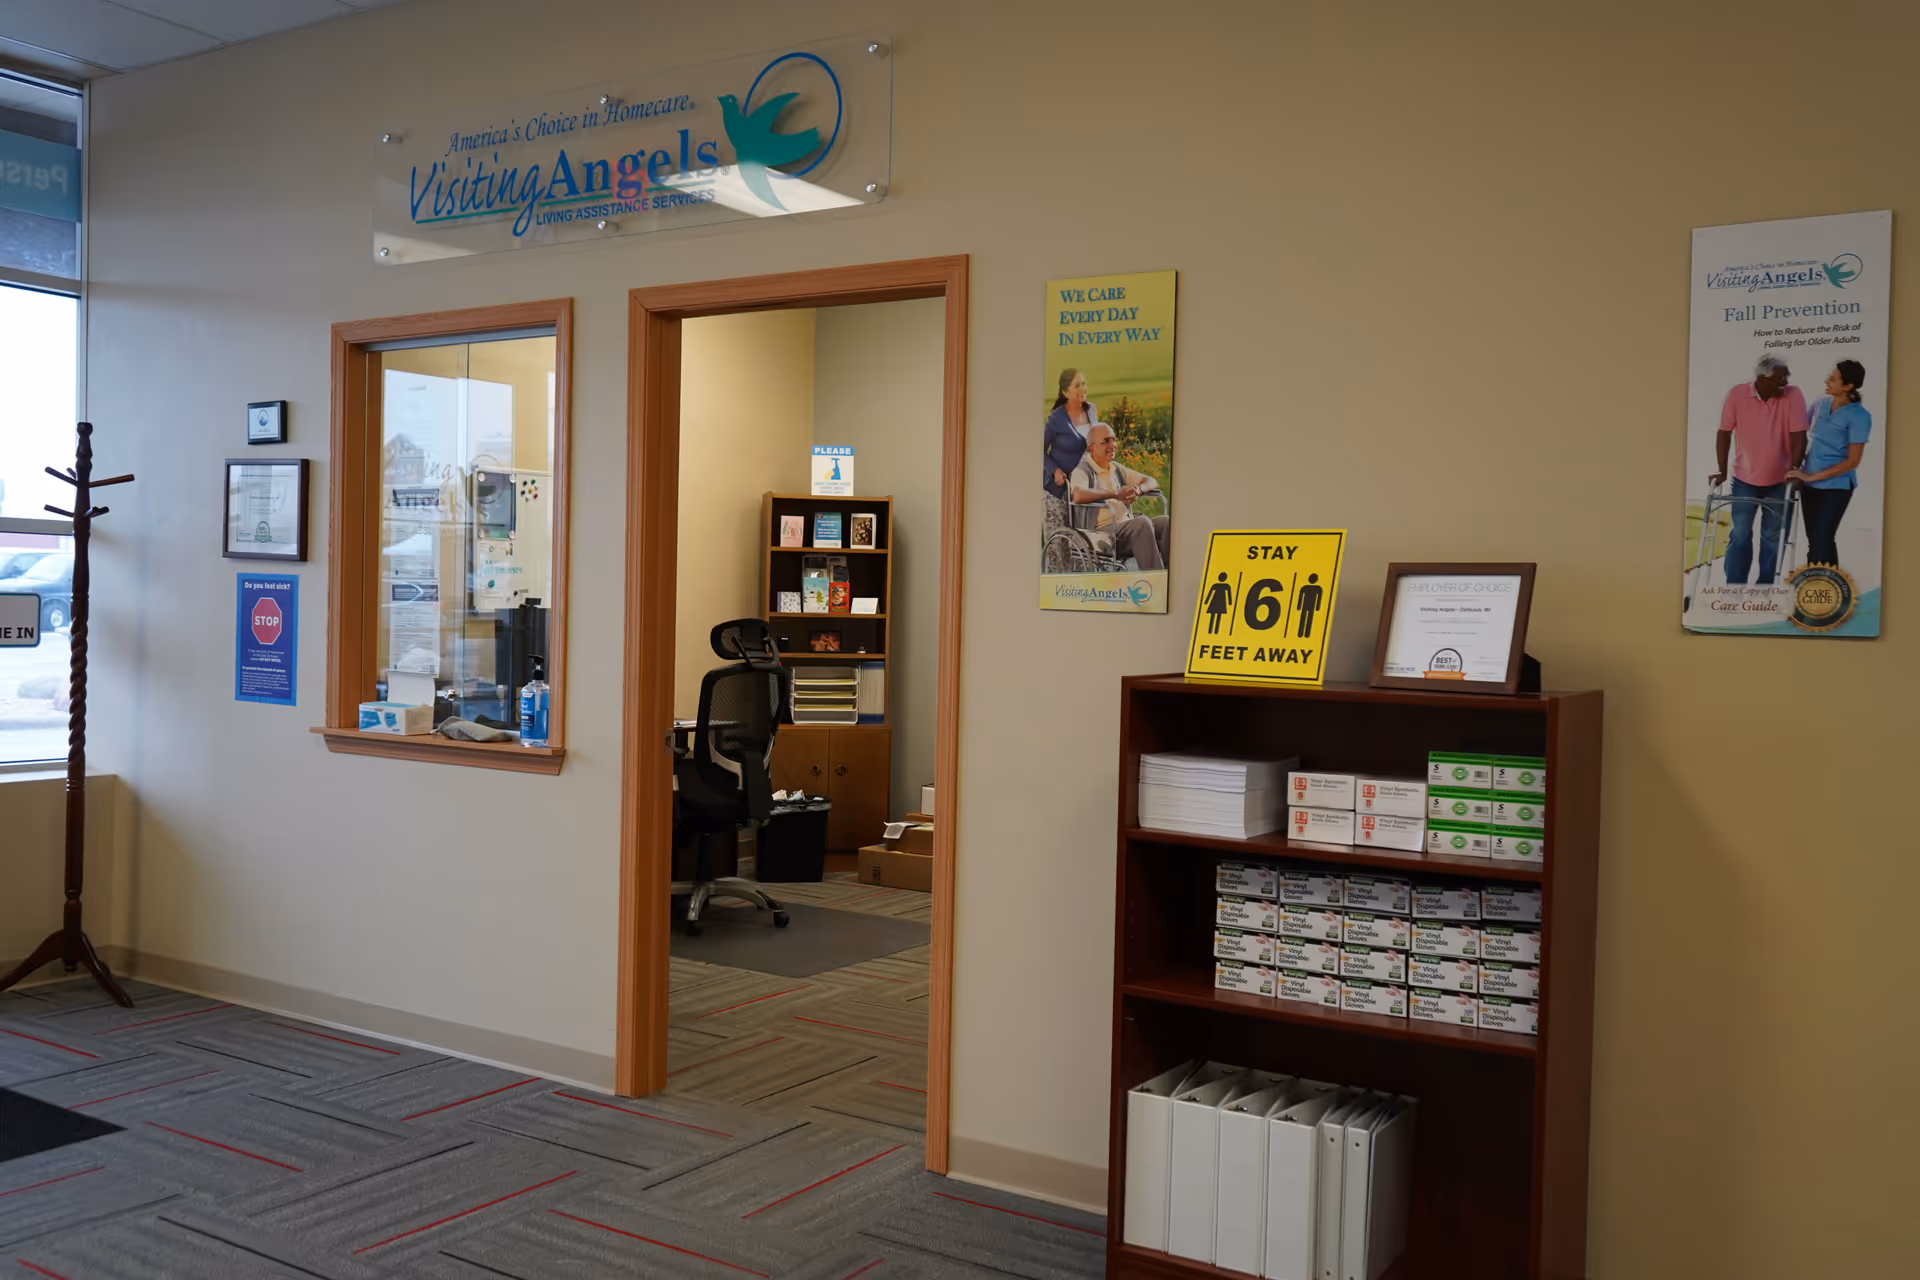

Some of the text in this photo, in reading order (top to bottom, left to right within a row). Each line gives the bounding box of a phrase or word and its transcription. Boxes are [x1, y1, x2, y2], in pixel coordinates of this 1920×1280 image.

[445, 119, 520, 157] America's
[525, 112, 577, 141] Choice
[583, 105, 598, 128] in
[411, 129, 719, 237] Visiting Angels
[537, 188, 714, 226] LIVING ASSISTANCE SERVICES
[1707, 271, 1761, 293] Visiting
[1761, 268, 1822, 284] Angels
[1060, 287, 1126, 303] WE CARE
[1060, 307, 1138, 324] EVERY DAY
[1724, 300, 1860, 322] Fall Prevention
[1754, 329, 1772, 337] How
[1785, 326, 1815, 335] Reduce
[1817, 325, 1831, 333] the
[1833, 324, 1849, 332] Risk
[1852, 323, 1862, 331] of
[1058, 328, 1160, 346] IN EVERY WAY
[1764, 340, 1792, 348] Falling
[1794, 339, 1806, 347] for
[1833, 336, 1860, 344] Adults
[815, 447, 851, 455] PLEASE
[1247, 546, 1298, 560] STAY
[1056, 585, 1128, 602] Visiting Angels
[1739, 587, 1760, 596] Copy
[1762, 587, 1772, 595] of
[1805, 589, 1831, 597] CARE
[1244, 579, 1283, 630] 6
[1803, 596, 1833, 604] GUIDE
[1711, 601, 1778, 612] Care Guide
[255, 616, 279, 625] STOP
[16, 627, 34, 639] IN
[1199, 645, 1313, 664] FEET AWAY
[1220, 878, 1248, 886] Disposable
[1221, 911, 1249, 919] Disposable
[1292, 916, 1306, 924] Vinyl
[1283, 921, 1313, 929] Disposable
[1348, 929, 1379, 937] Disposable
[1416, 938, 1448, 946] Disposable
[1218, 944, 1246, 952] Disposable
[1485, 944, 1519, 952] Disposable
[1279, 953, 1309, 961] Disposable
[1219, 975, 1247, 984] Disposable
[1413, 972, 1445, 980] Disposable
[1484, 979, 1517, 988] Disposable
[1281, 985, 1311, 994] Disposable
[1345, 996, 1376, 1004] Disposable
[1414, 1005, 1446, 1013] Disposable
[1483, 1014, 1516, 1022] Disposable
